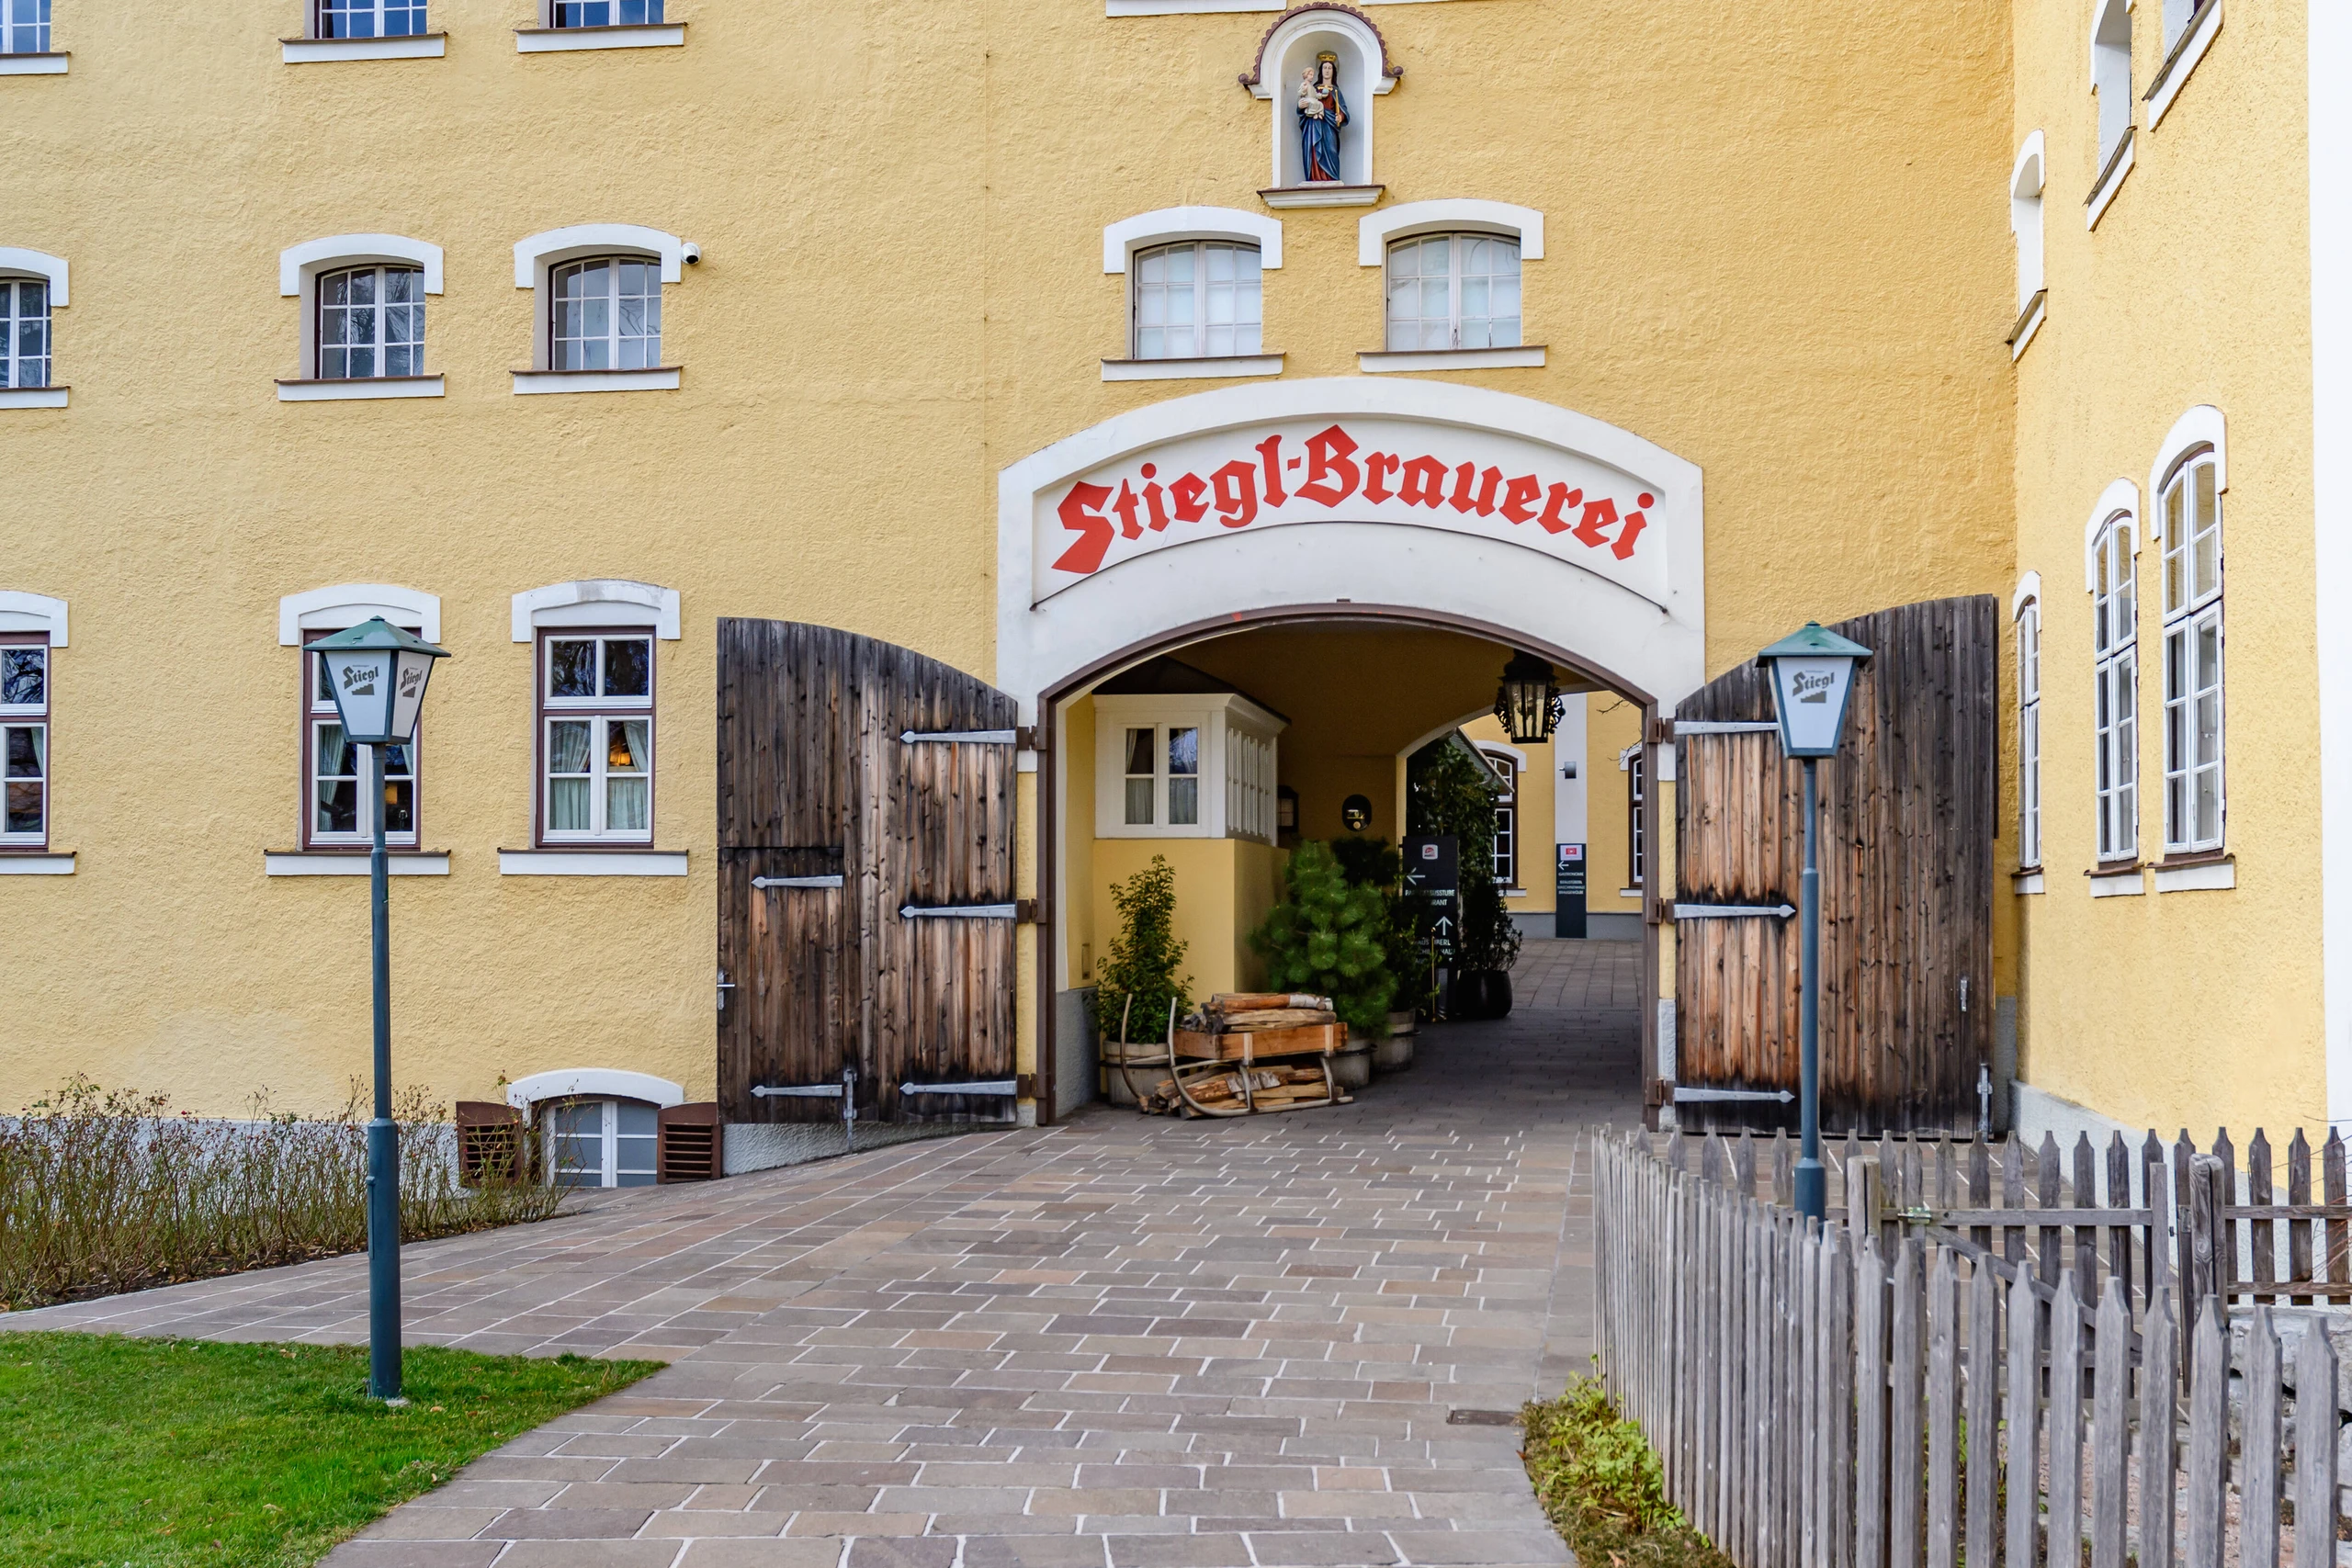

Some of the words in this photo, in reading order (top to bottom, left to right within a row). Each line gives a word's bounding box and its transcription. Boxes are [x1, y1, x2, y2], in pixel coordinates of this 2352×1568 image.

[1051, 424, 1655, 574] Stiegl-Brauerei
[343, 666, 379, 690] Stiegl
[400, 668, 423, 691] Stiegl
[1792, 671, 1835, 697] Stiegl
